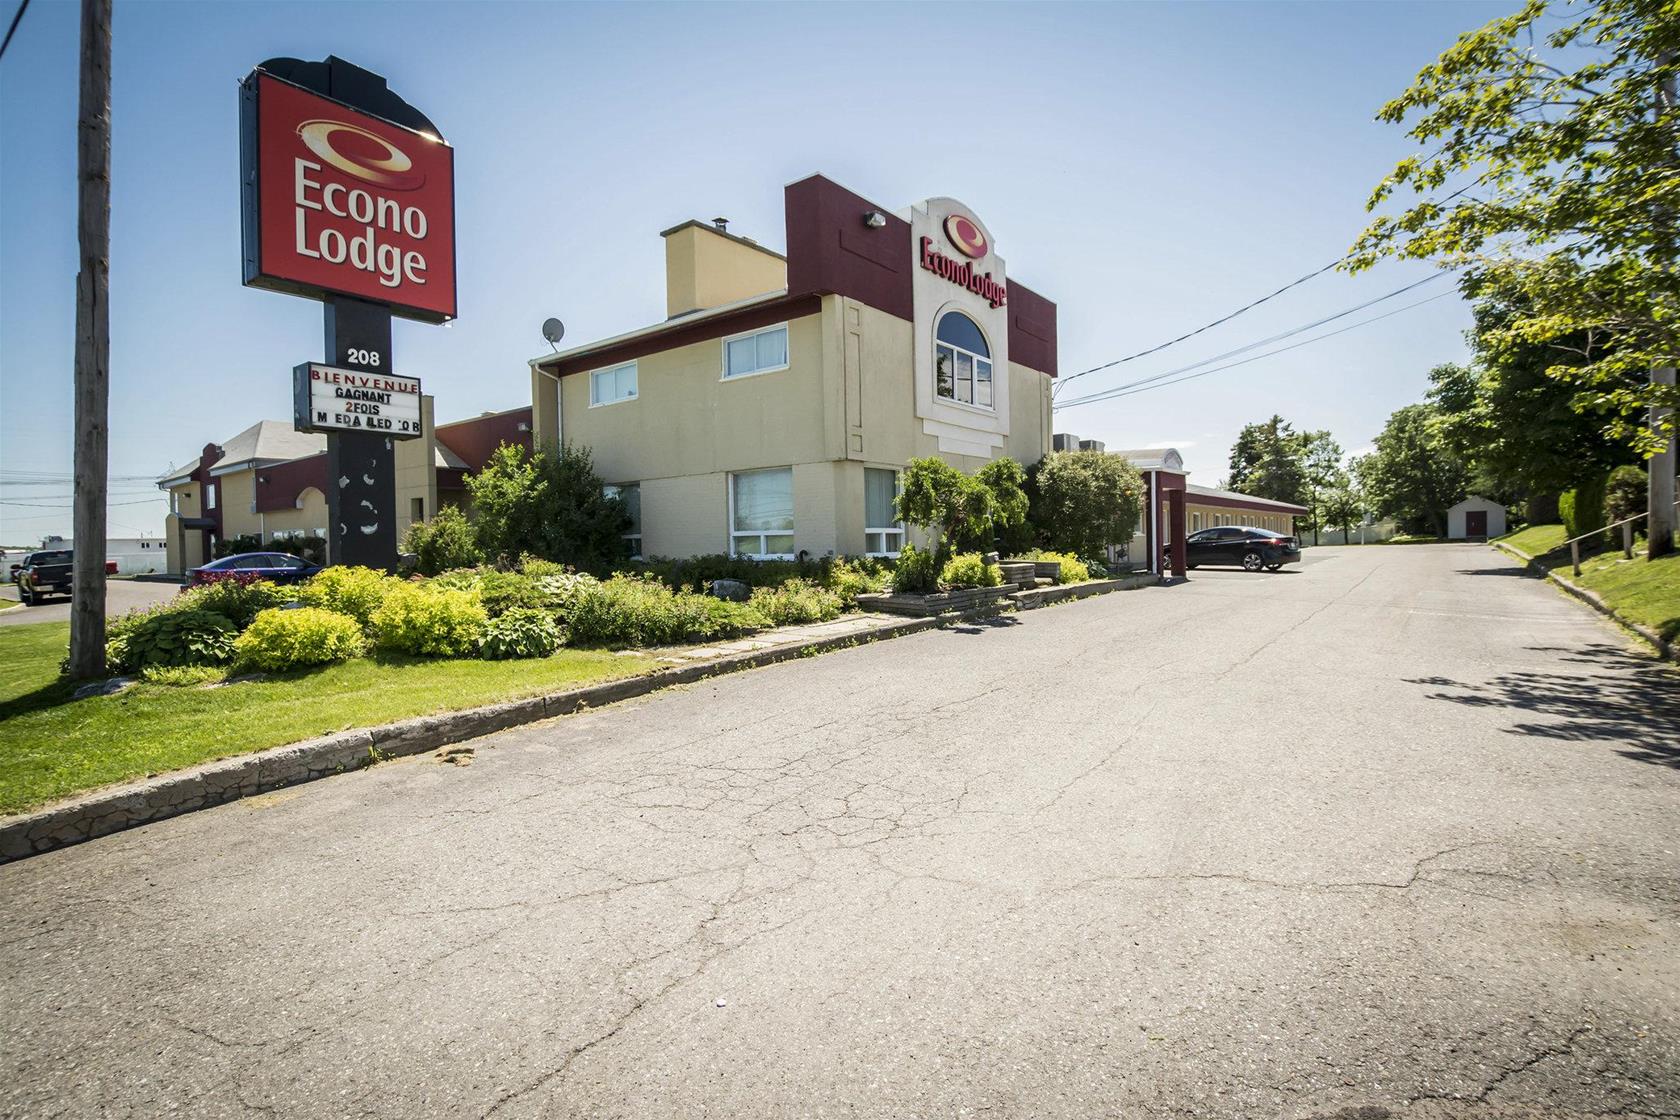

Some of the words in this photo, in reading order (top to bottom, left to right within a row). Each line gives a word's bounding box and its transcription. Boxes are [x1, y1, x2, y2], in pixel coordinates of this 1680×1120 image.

[295, 157, 427, 239] Econo
[295, 207, 427, 287] Lodge
[348, 348, 380, 366] 208
[311, 370, 418, 393] BIENVENUE
[335, 387, 391, 404] GAGNANT
